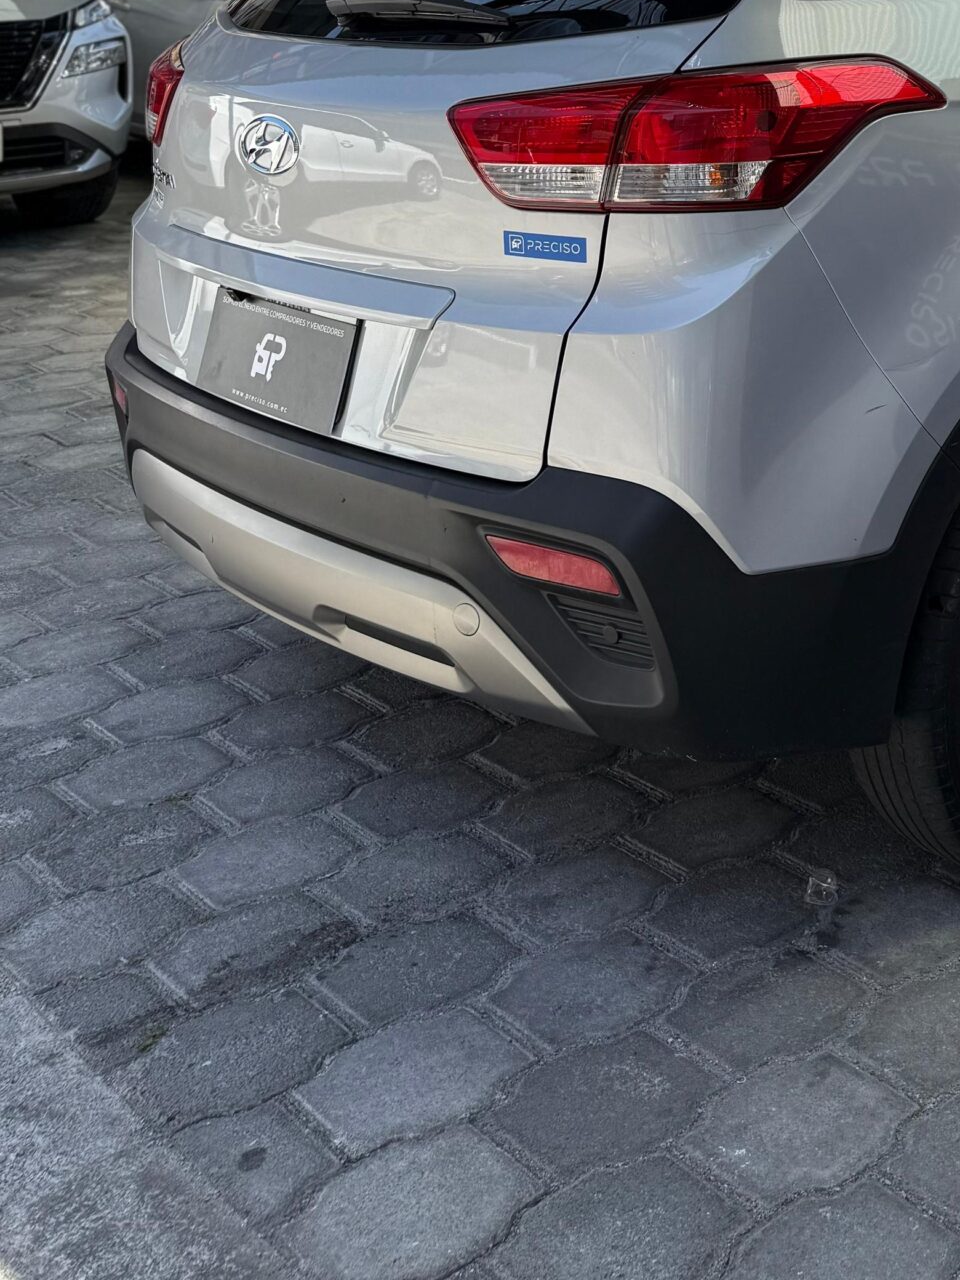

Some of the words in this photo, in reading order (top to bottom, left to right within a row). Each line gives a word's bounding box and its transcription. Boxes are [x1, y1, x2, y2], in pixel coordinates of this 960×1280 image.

[527, 239, 580, 254] PRECISO
[255, 305, 270, 317] ENTRE
[269, 310, 306, 327] COMPRADORES
[310, 321, 345, 338] VENDEDORES
[231, 388, 288, 414] www.preciso.com.ec
